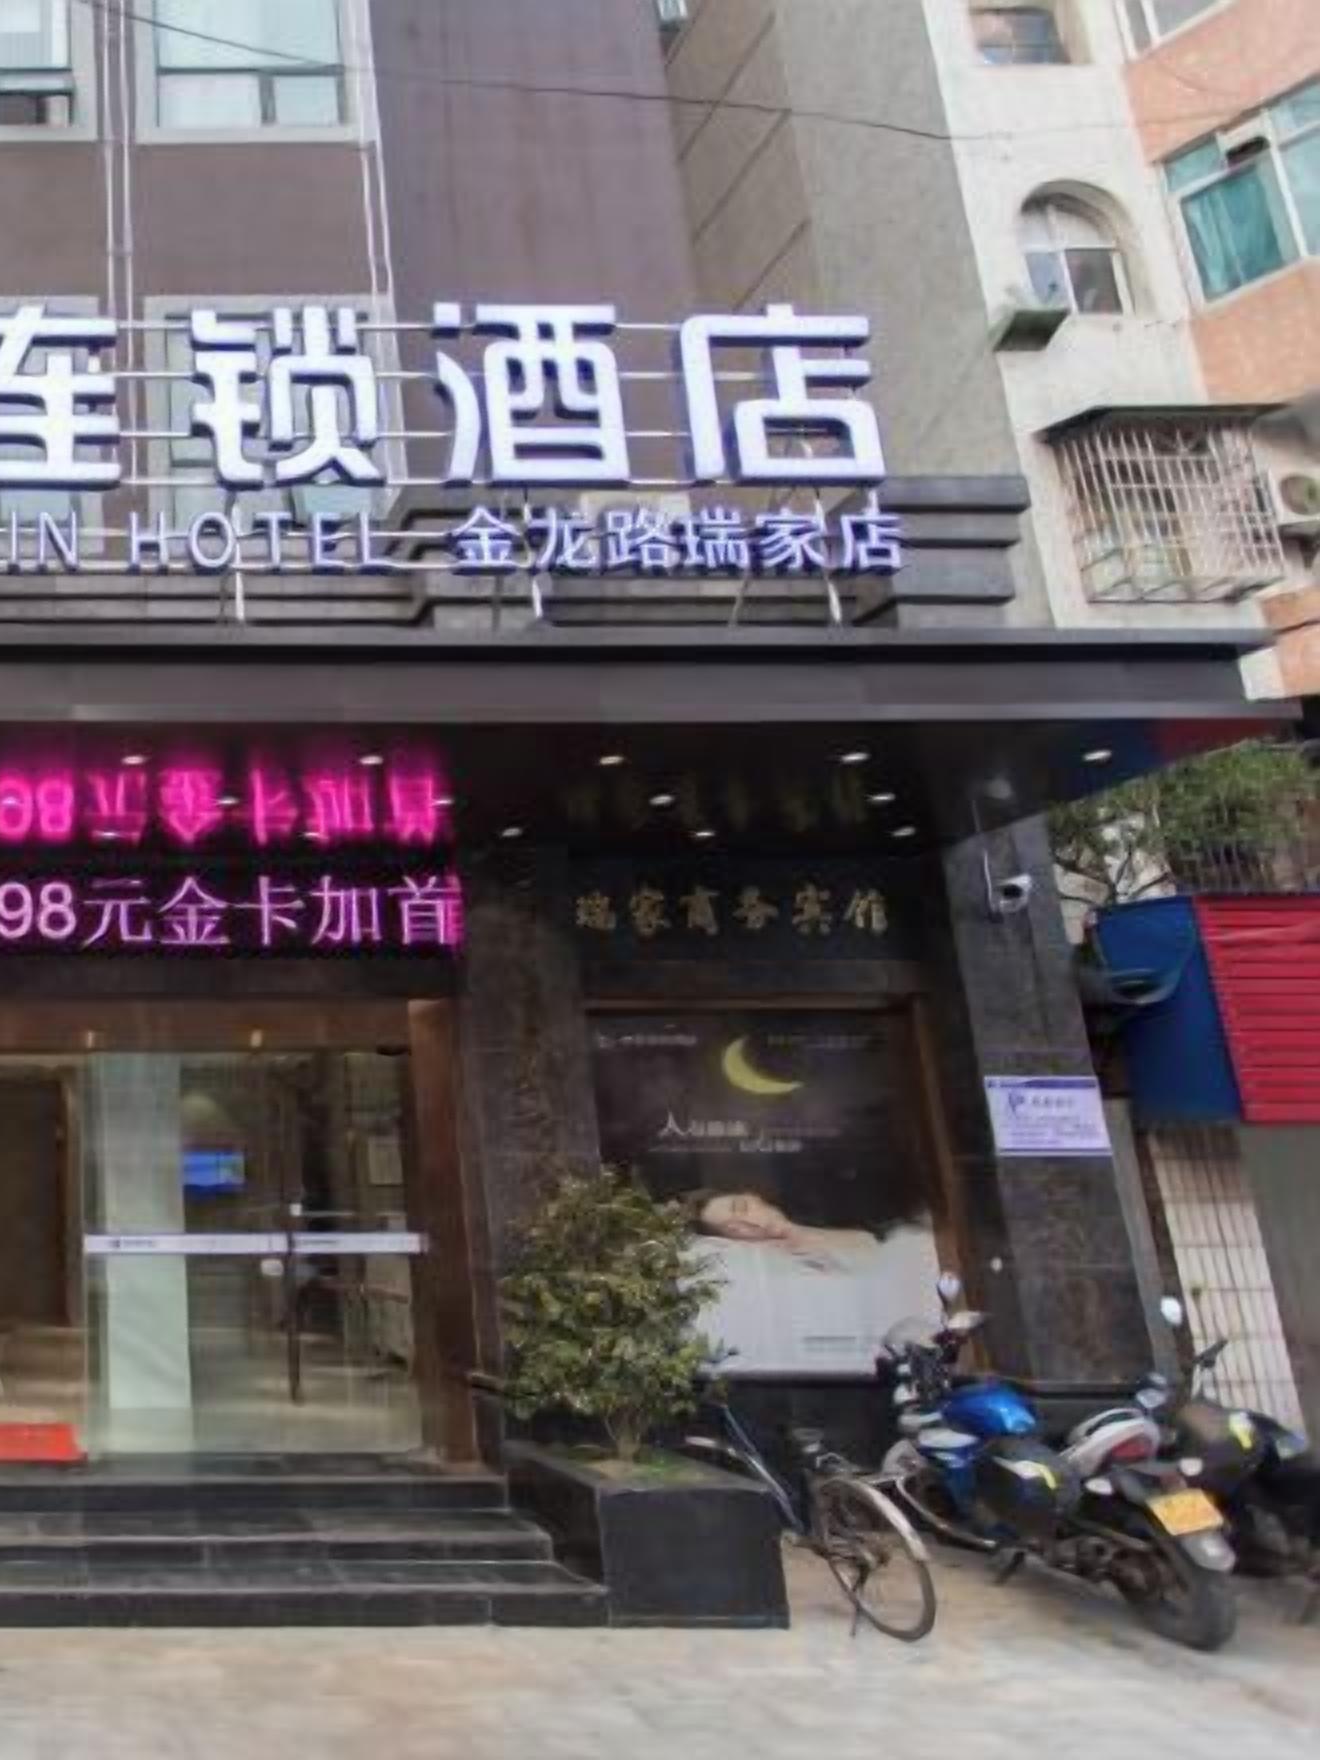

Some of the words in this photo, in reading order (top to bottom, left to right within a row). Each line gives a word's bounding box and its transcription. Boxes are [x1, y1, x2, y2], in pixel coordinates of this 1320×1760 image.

[128, 510, 378, 571] HOTEL
[450, 506, 904, 573] 金龙路瑞家店
